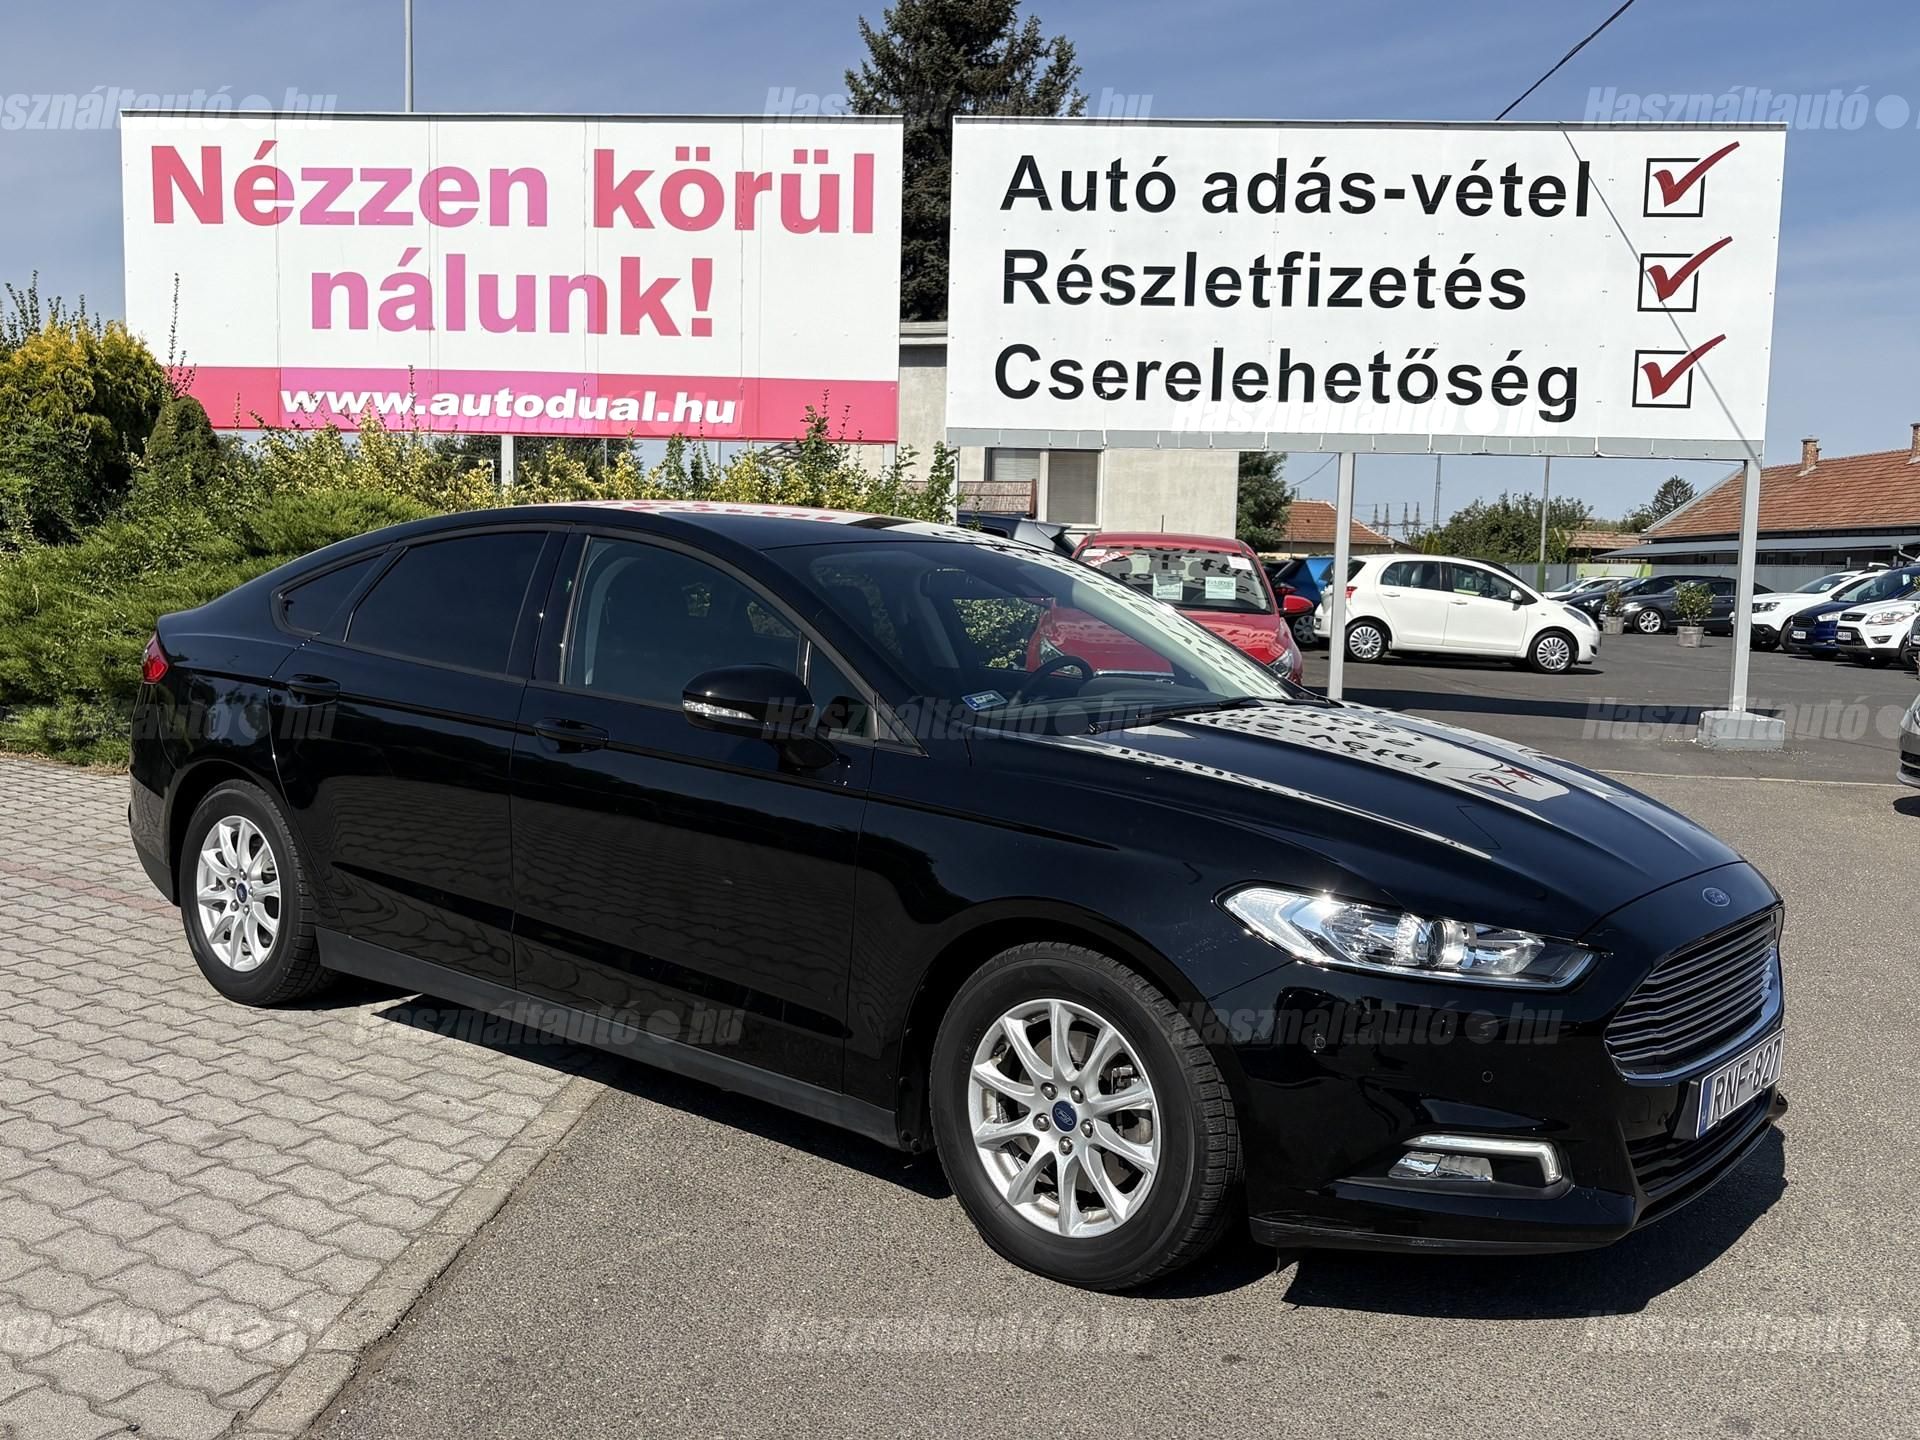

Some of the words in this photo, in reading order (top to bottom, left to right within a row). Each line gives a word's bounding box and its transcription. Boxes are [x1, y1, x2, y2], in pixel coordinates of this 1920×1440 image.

[151, 141, 547, 227] Nézzen
[594, 147, 874, 234] körül
[1000, 155, 1176, 212] Autó
[1203, 150, 1590, 217] adás-vétel
[312, 248, 713, 337] nálunk!
[1003, 249, 1526, 309] Részletfizetés
[280, 388, 736, 424] www.autodual.hu
[995, 344, 1578, 422] Cserelehetőség
[1711, 1036, 1781, 1121] RNF-827
